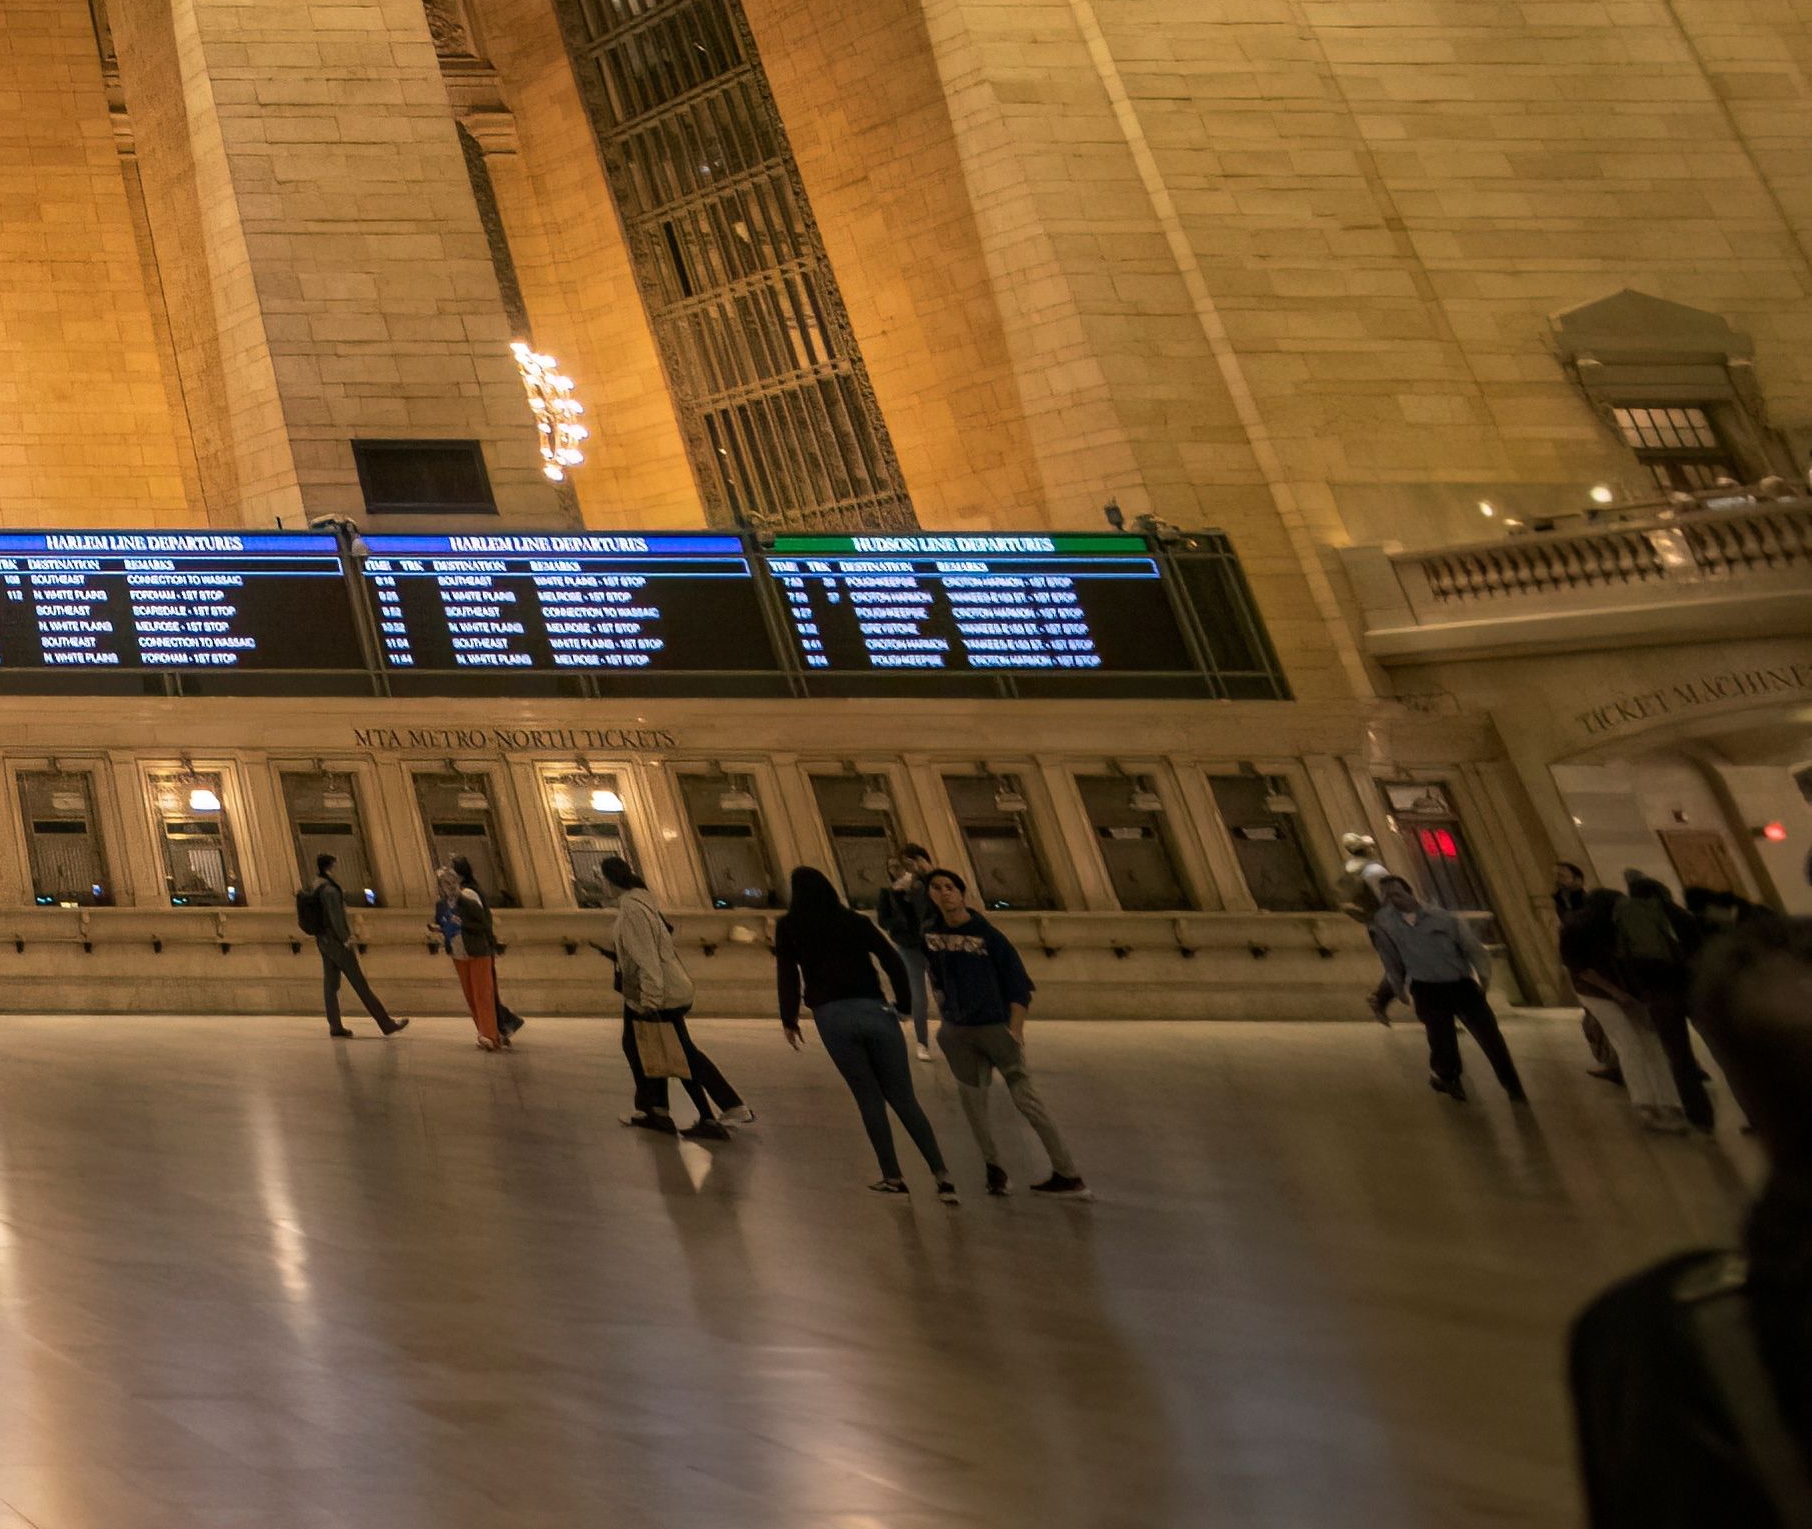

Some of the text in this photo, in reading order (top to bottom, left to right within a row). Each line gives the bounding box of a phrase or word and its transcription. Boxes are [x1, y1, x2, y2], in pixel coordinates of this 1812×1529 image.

[45, 536, 243, 550] HARLEM LINE DEPARTURES
[449, 537, 648, 551] HARLEM LINE DEPARTURES
[851, 537, 1054, 551] HUDSON LINE DEPARTURES
[27, 559, 100, 569] DESTINATION
[432, 560, 506, 571] DESTINATION
[1575, 663, 1812, 734] TICKET MACHINE
[354, 728, 400, 748] MTA
[582, 729, 677, 750] TICKETS
